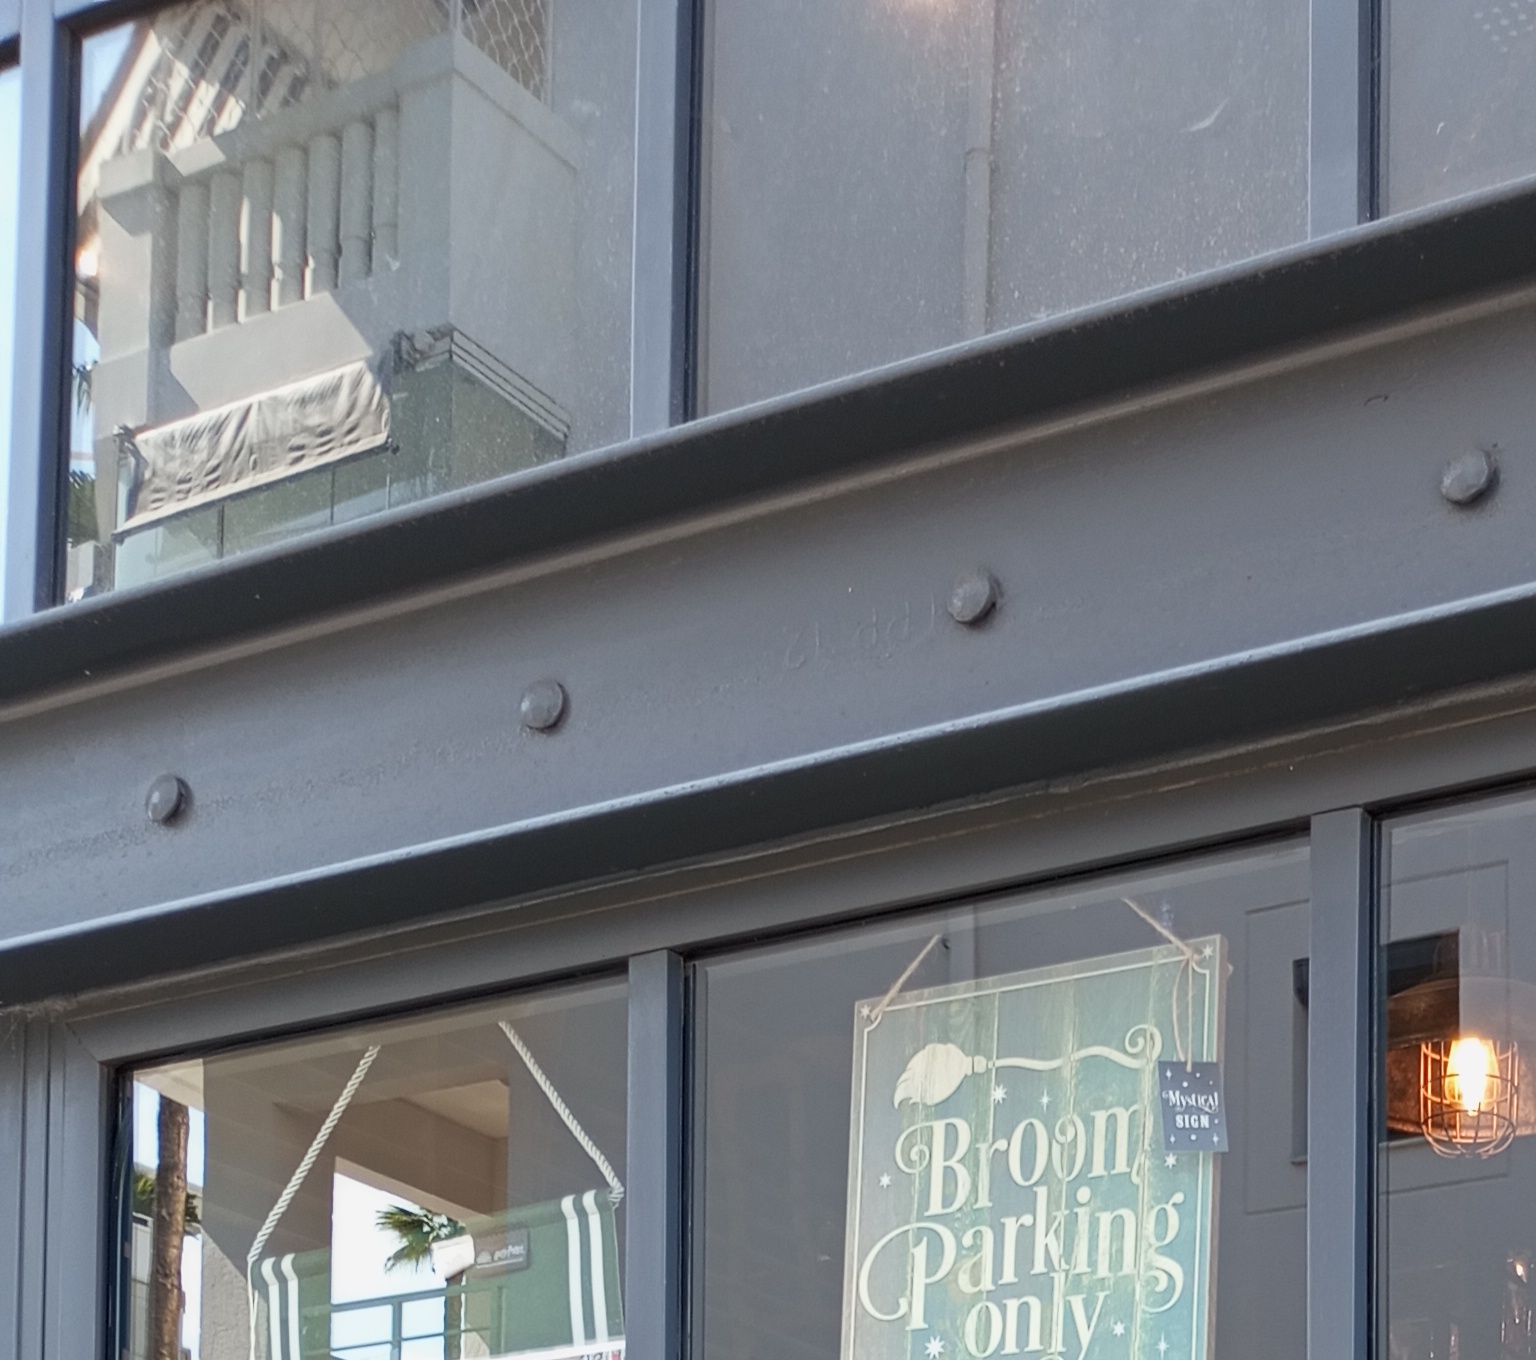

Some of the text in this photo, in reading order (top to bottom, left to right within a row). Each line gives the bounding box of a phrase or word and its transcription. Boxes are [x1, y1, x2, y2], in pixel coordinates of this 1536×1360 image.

[895, 1103, 1153, 1216] Broom
[1175, 1115, 1210, 1129] SIGN
[859, 1186, 1185, 1331] Parking
